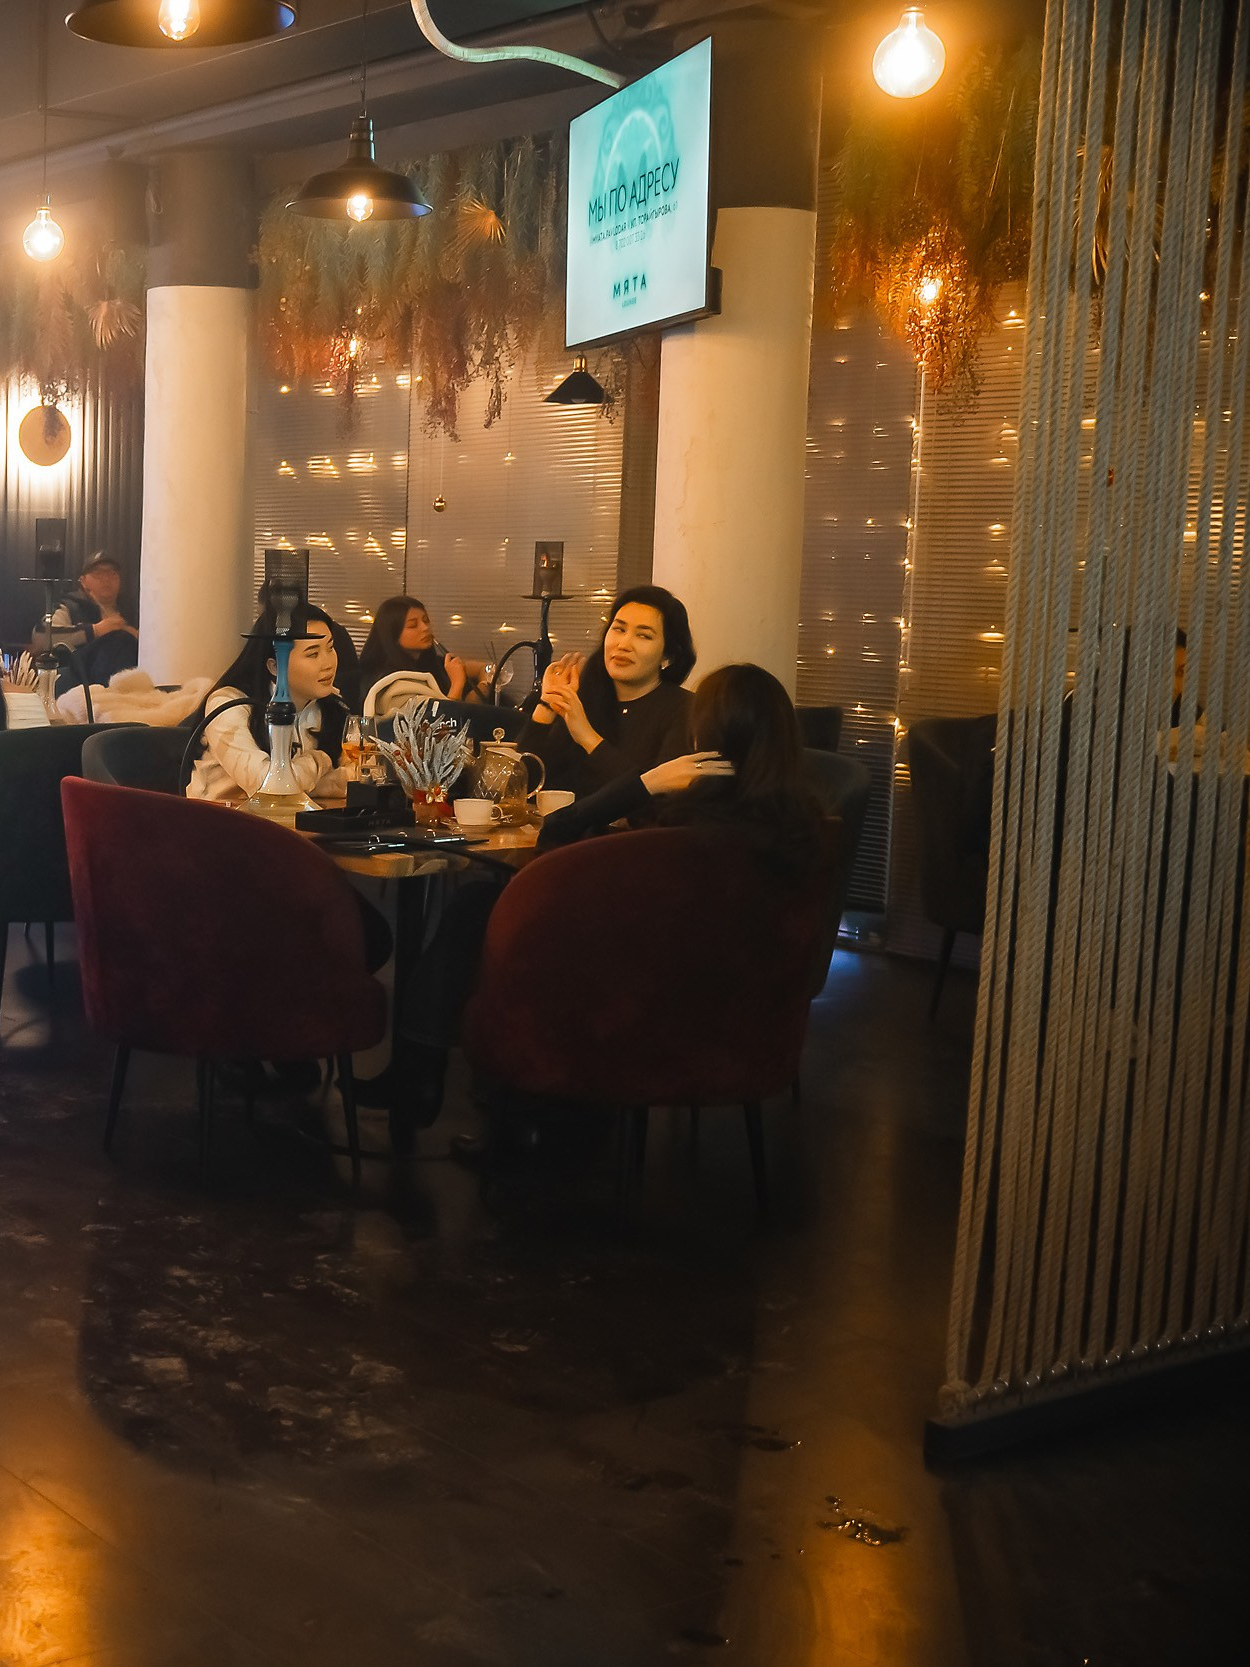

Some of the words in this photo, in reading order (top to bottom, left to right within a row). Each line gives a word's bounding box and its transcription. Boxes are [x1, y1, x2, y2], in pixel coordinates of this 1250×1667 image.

[588, 192, 607, 227] МЫ
[609, 184, 627, 216] ПО
[629, 157, 680, 210] АДРЕСУ
[612, 273, 647, 299] МЯТА
